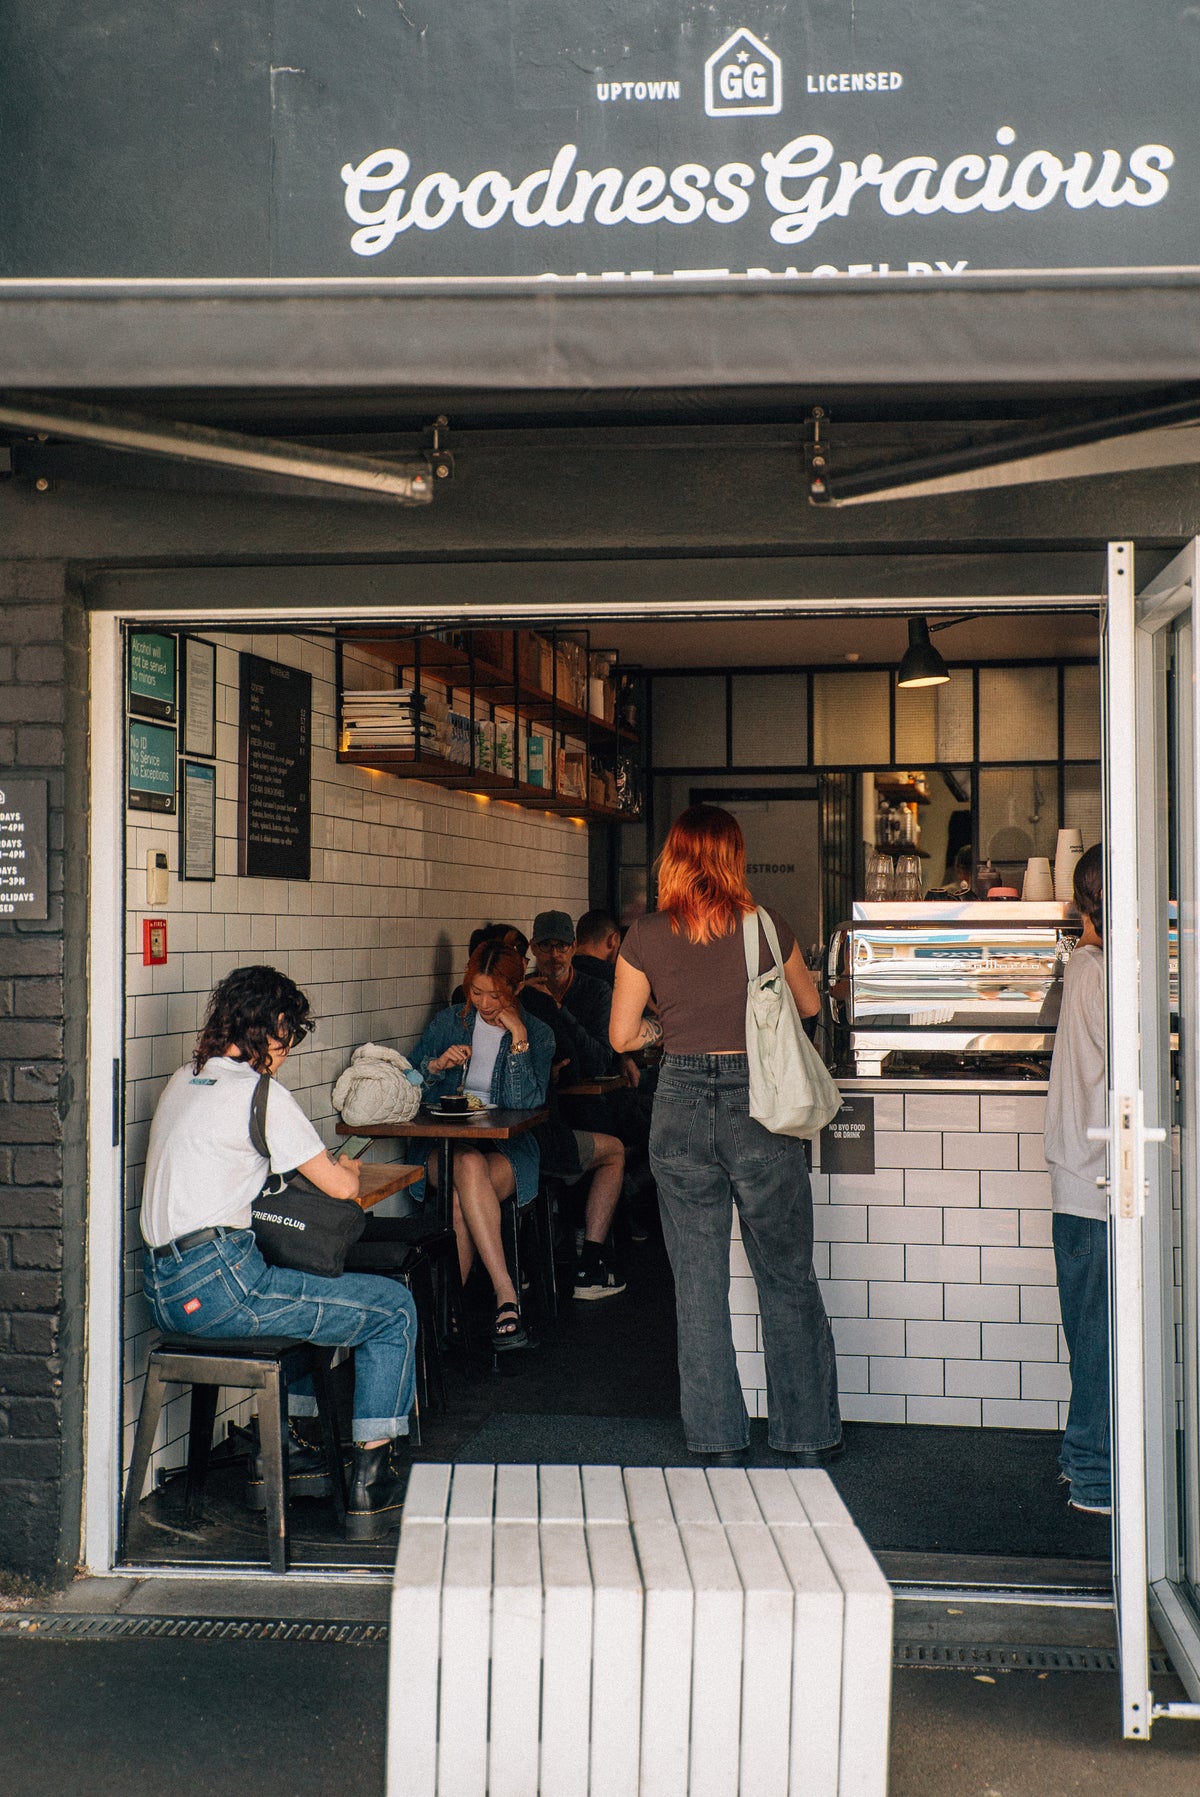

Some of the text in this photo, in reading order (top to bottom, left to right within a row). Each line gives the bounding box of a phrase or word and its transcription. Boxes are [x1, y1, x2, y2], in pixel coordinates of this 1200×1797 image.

[720, 63, 767, 99] GG
[807, 72, 903, 94] LICENSED
[597, 81, 680, 101] UPTOWN
[340, 125, 1175, 256] Goodness Gracious
[131, 638, 162, 659] Alcohol will
[131, 655, 167, 675] not be served
[131, 669, 156, 686] to minors
[130, 734, 148, 750] No ID
[130, 748, 160, 766] No Service
[130, 763, 140, 777] No
[140, 764, 169, 782] Exceptions
[0, 839, 22, 848] DAYS
[0, 866, 18, 875] AYS
[746, 863, 795, 874] ESTROOM
[828, 1123, 838, 1131] NO
[850, 1123, 866, 1131] FOOD
[833, 1131, 861, 1139] OR DRINK
[252, 1210, 306, 1231] FRIENDS CLUB
